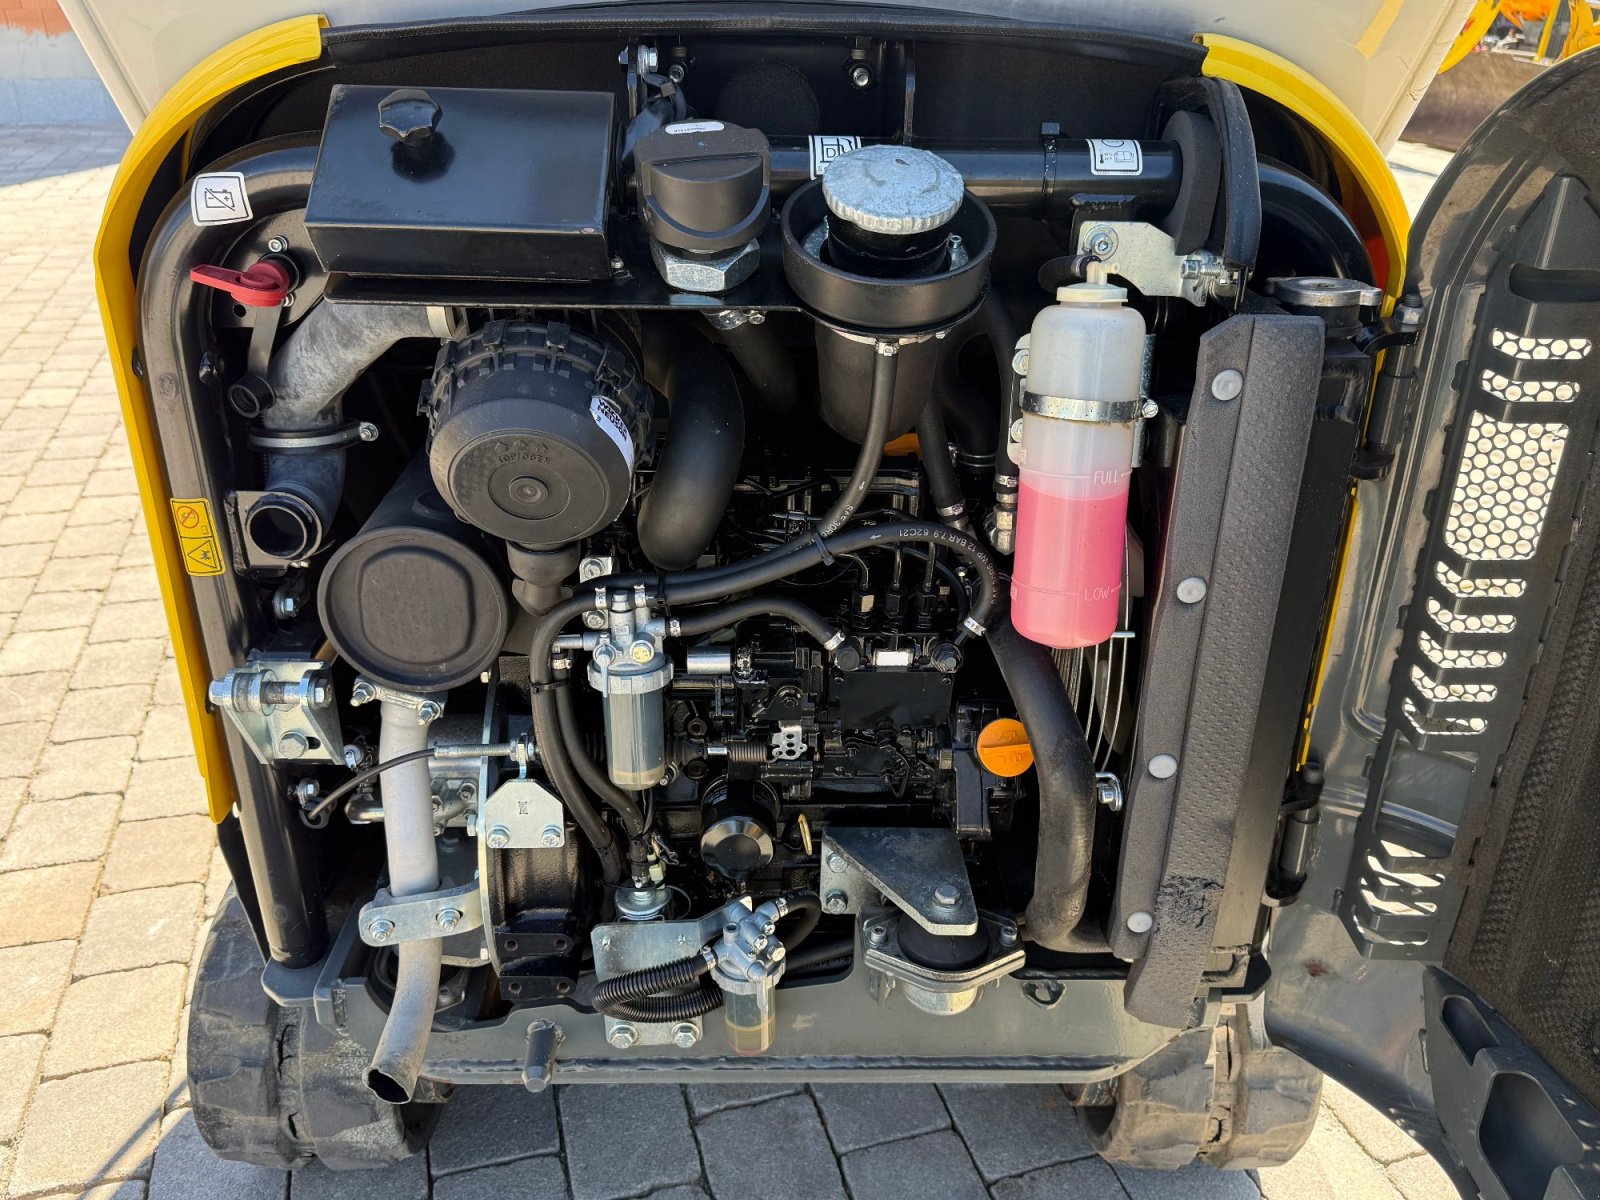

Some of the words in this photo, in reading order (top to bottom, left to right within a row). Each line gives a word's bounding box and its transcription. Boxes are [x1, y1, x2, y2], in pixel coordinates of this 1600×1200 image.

[1094, 470, 1119, 485] FULL
[948, 533, 967, 547] BAR
[967, 541, 977, 552] 12
[1085, 586, 1110, 601] LOW
